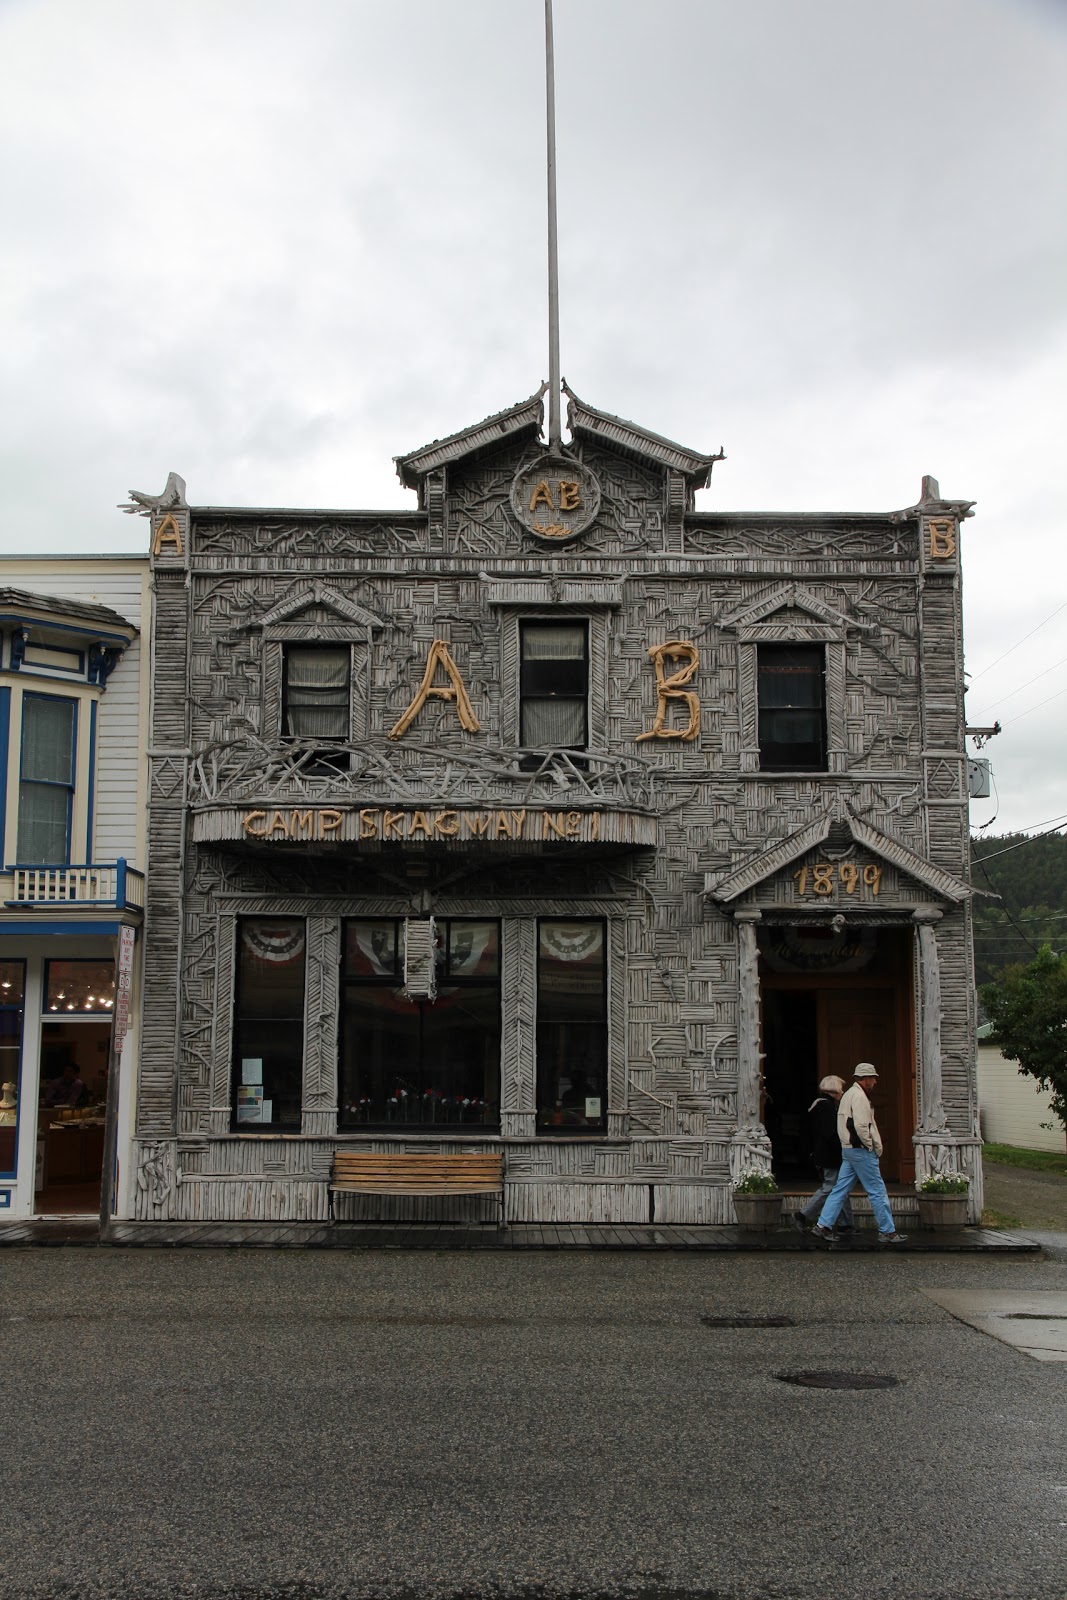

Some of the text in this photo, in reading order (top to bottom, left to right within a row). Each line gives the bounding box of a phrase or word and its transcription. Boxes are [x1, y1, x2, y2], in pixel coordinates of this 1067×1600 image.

[153, 513, 182, 556] A
[928, 518, 956, 558] B
[242, 809, 342, 839] CAMP
[359, 808, 527, 839] SKAGWAY
[793, 863, 882, 895] 1899
